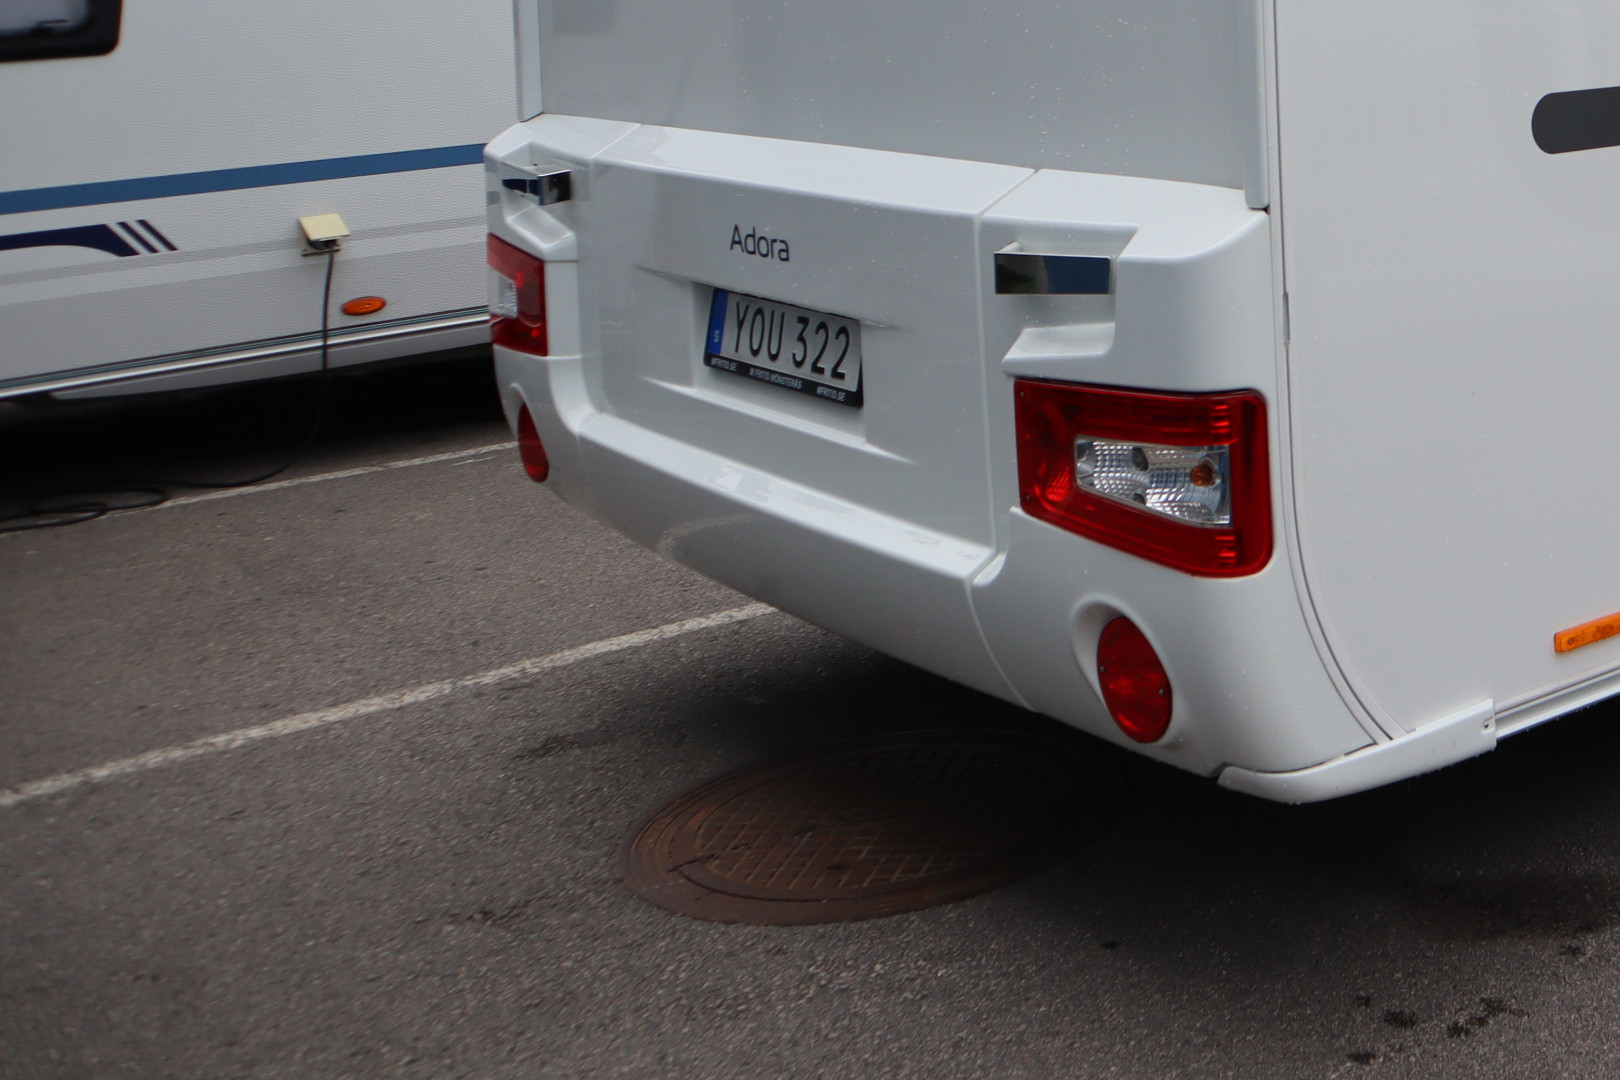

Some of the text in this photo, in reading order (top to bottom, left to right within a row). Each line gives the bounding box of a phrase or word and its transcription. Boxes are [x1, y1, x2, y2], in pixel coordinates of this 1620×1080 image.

[730, 224, 790, 262] Adora
[735, 302, 850, 380] YOU 322
